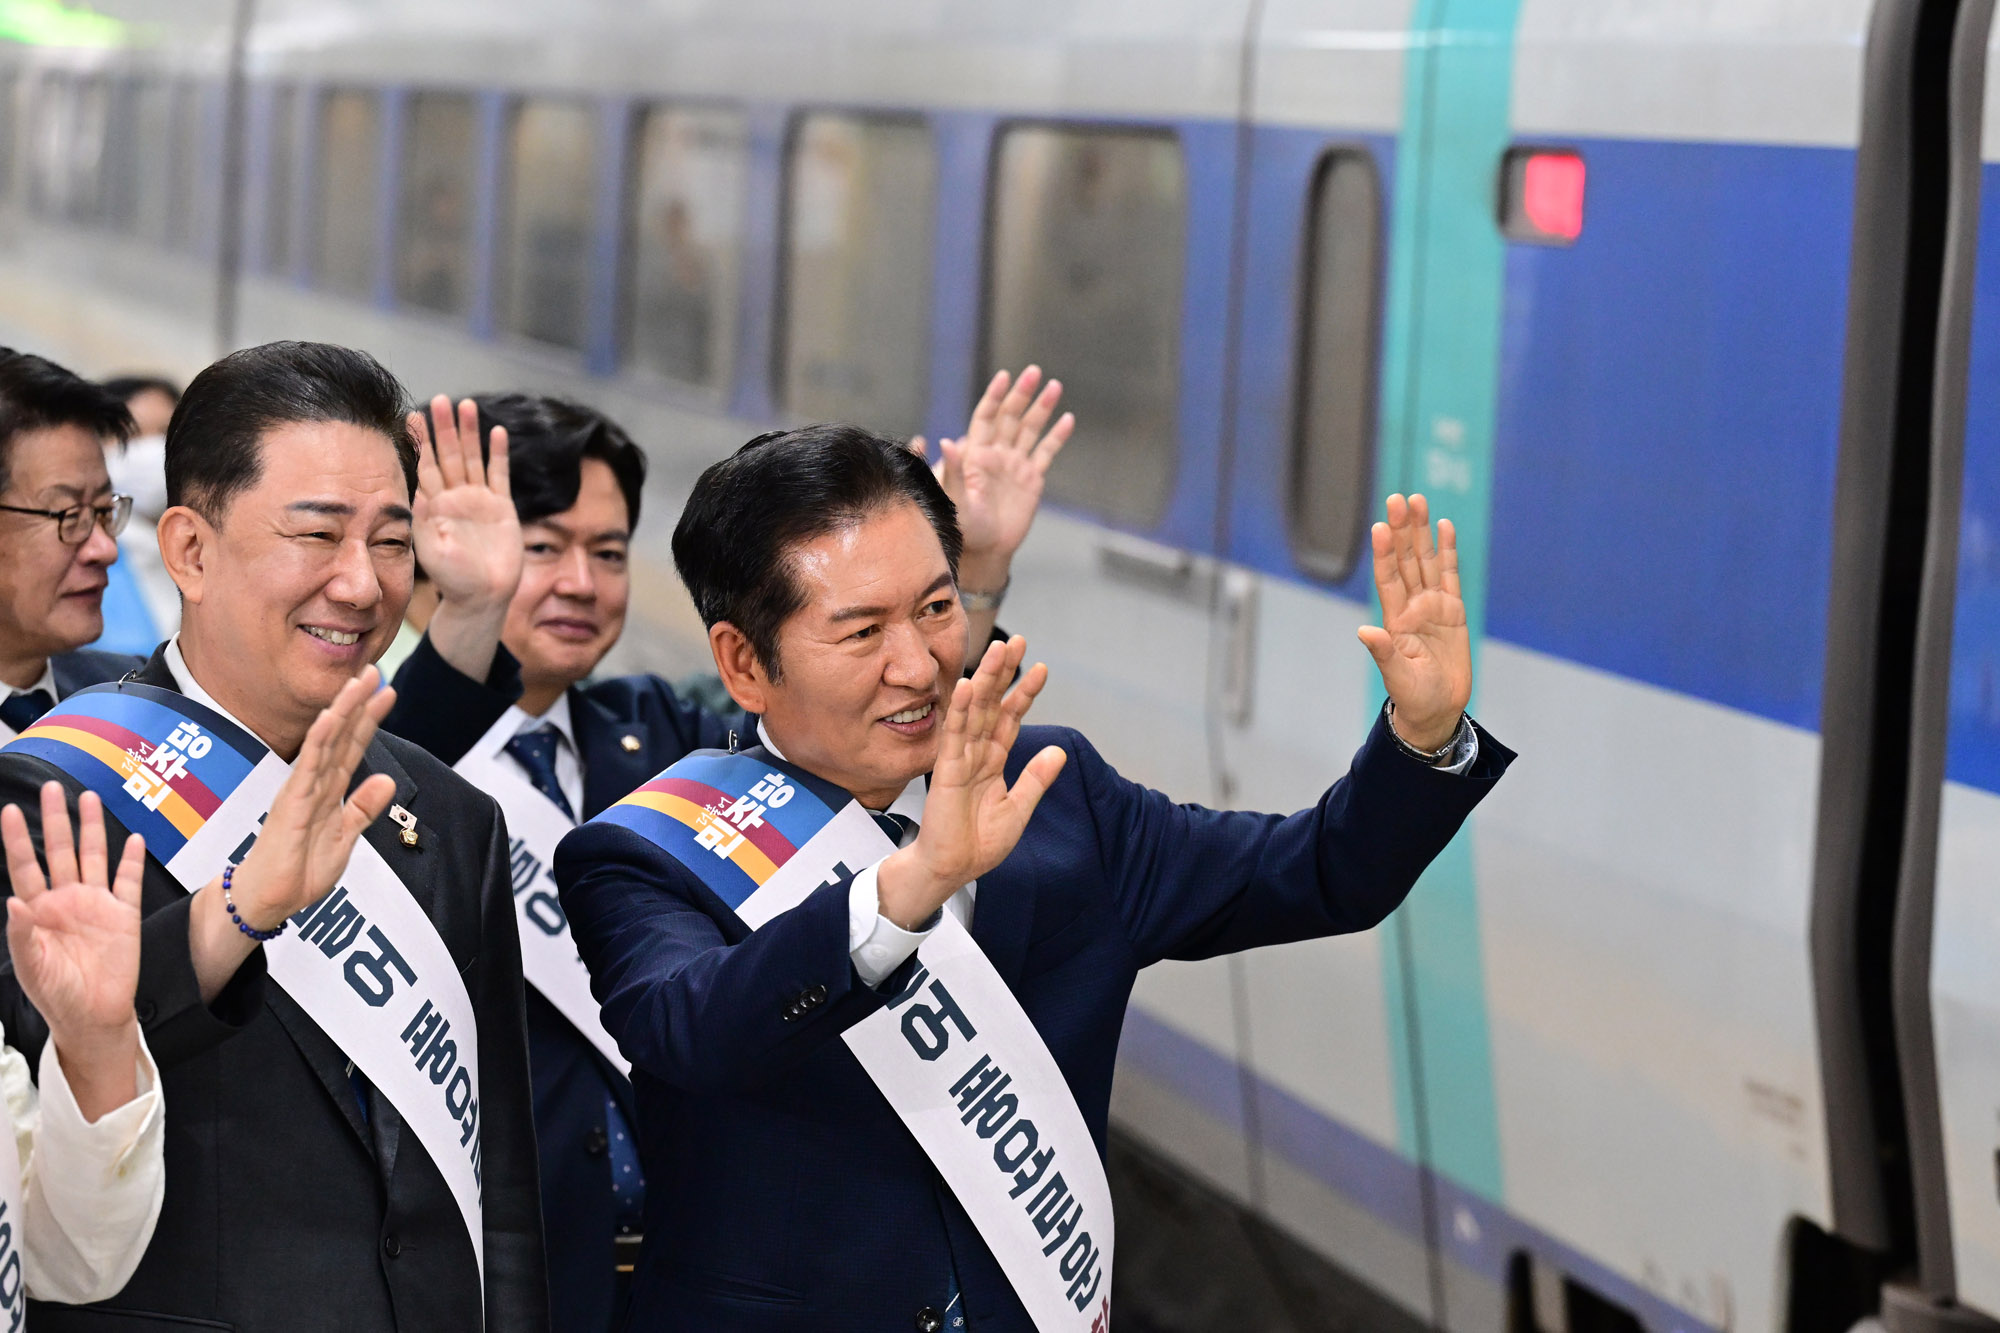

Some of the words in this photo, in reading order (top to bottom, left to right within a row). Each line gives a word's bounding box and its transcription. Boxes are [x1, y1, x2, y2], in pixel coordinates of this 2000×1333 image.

[121, 741, 154, 773] 더불어
[122, 721, 213, 812] 민주당
[693, 772, 796, 860] 민주당
[696, 796, 733, 825] 더불어
[948, 1053, 1102, 1313] 풍요로운
